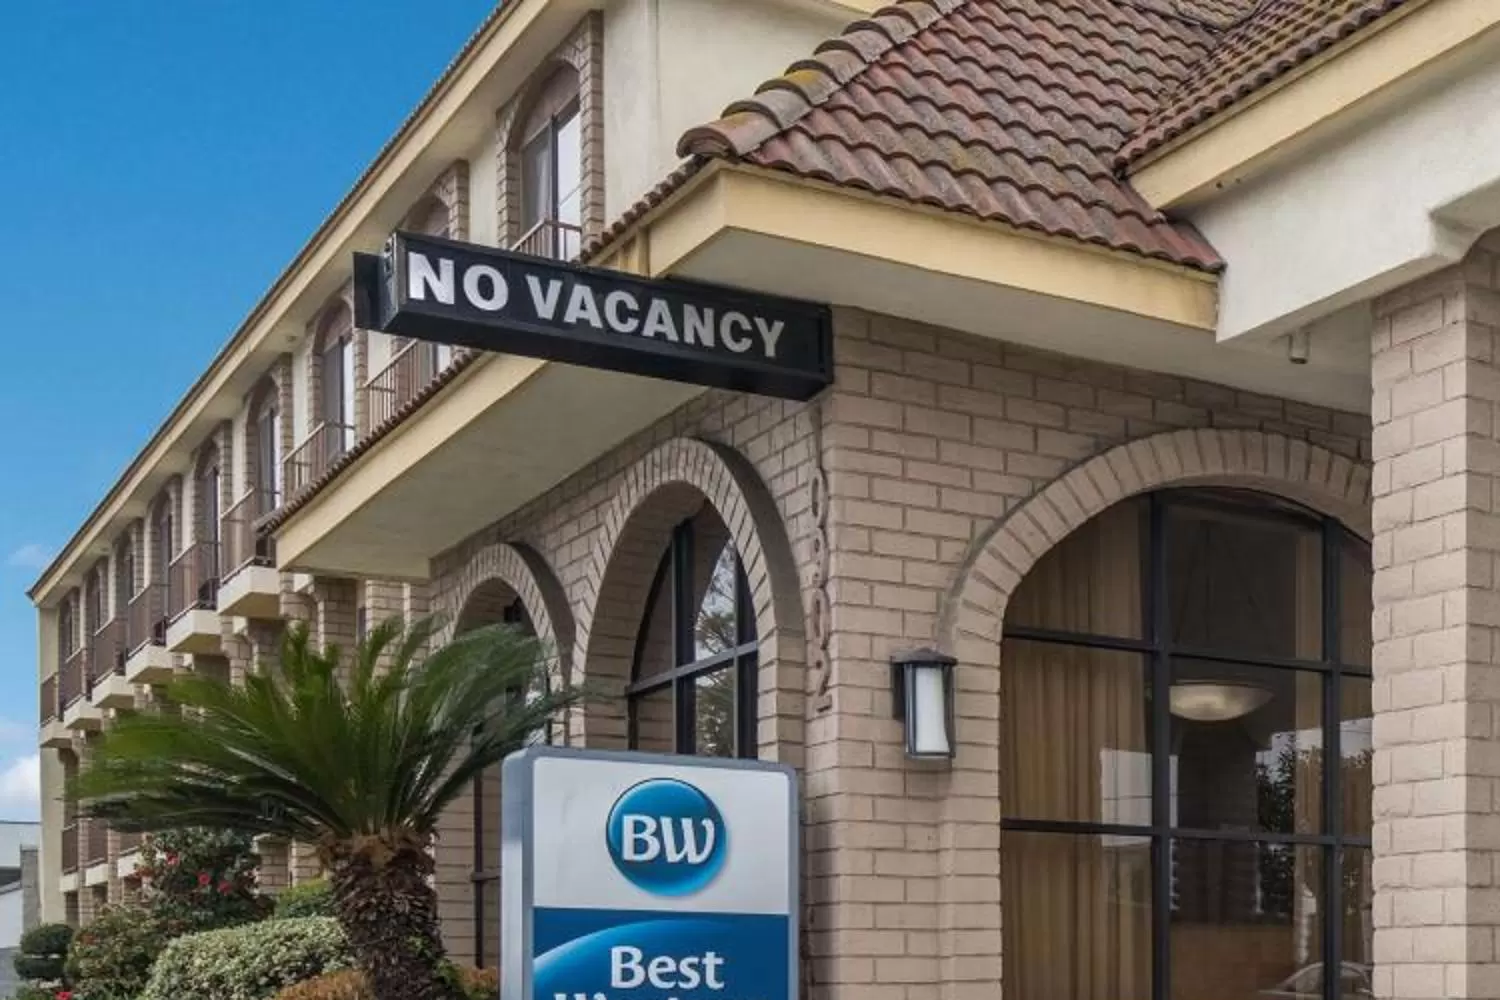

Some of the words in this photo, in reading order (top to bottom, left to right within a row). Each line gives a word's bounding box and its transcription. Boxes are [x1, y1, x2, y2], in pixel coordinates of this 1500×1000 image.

[407, 251, 509, 311] NO
[525, 274, 785, 358] VACANCY
[622, 814, 715, 864] BW
[610, 945, 725, 990] Best
